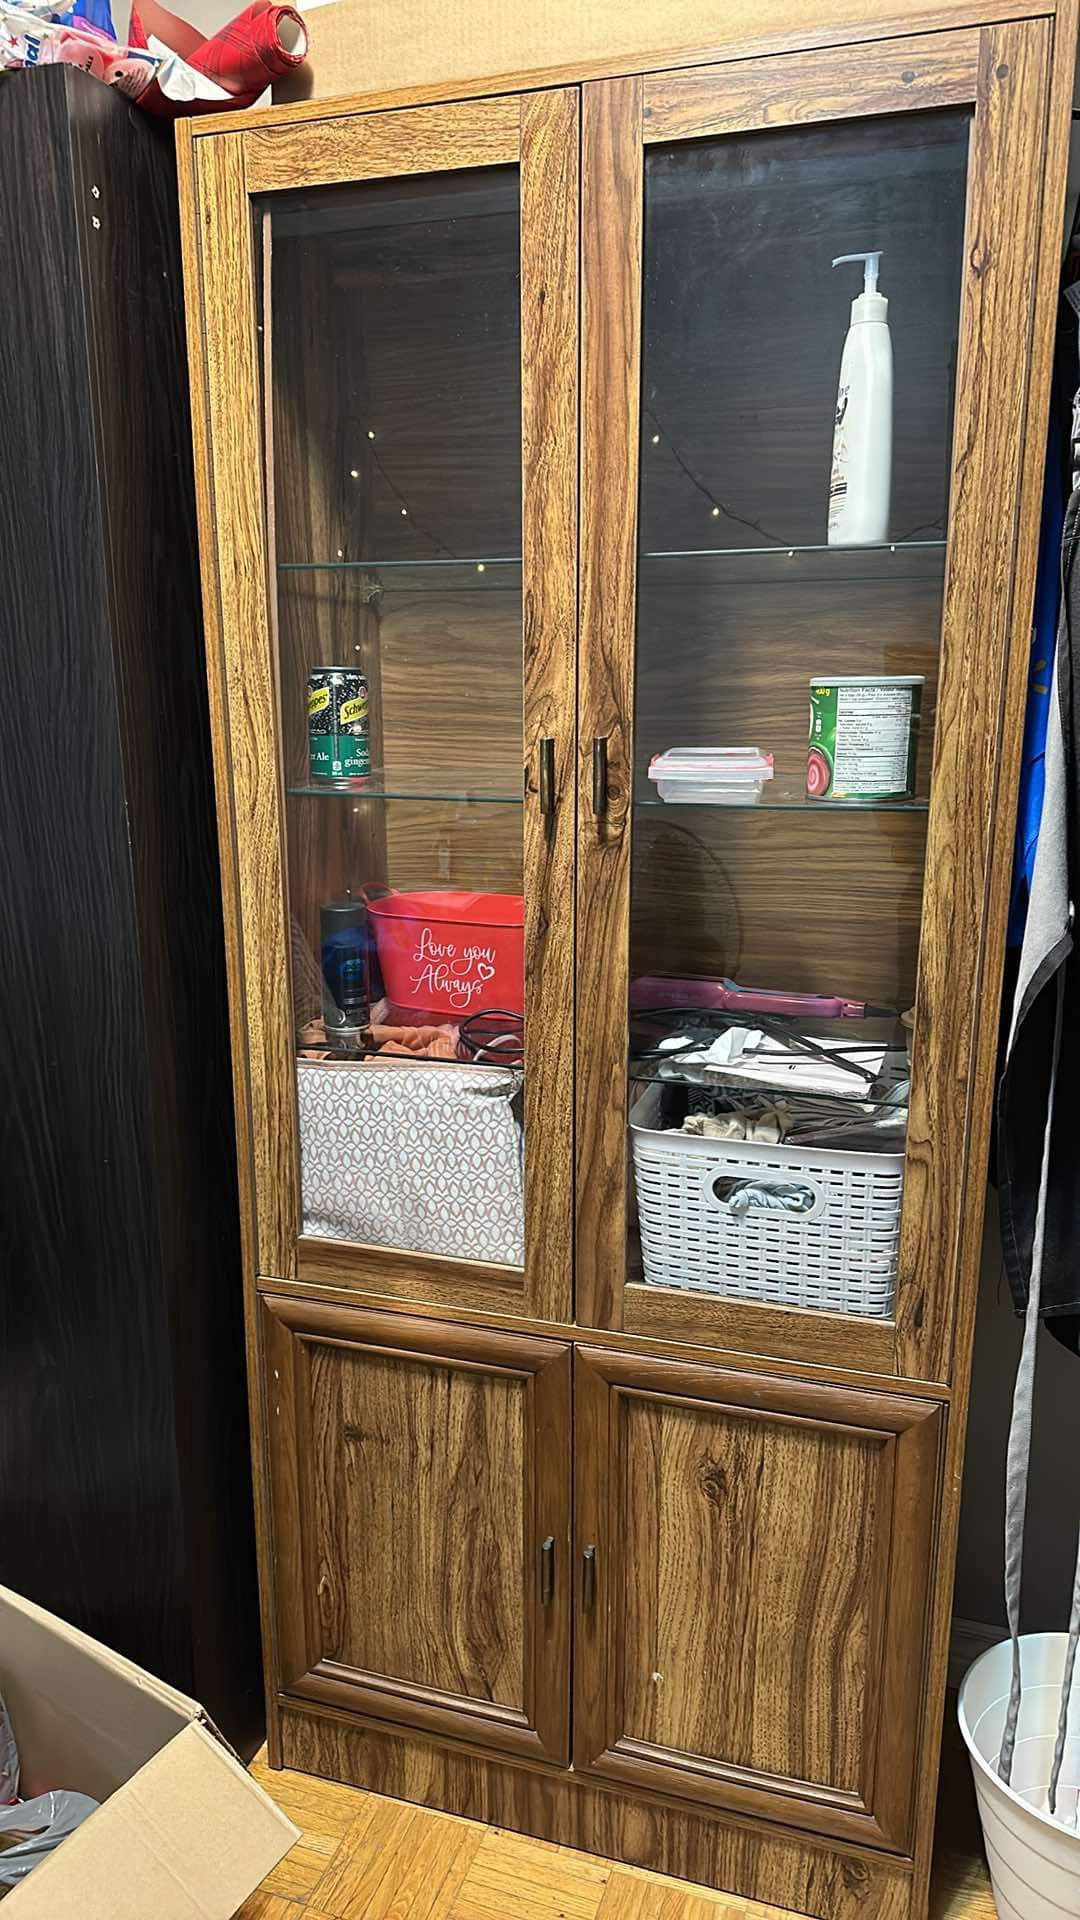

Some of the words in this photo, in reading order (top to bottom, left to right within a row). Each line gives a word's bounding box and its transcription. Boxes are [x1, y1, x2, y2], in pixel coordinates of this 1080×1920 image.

[317, 752, 330, 761] Ale
[412, 927, 457, 963] Love
[450, 945, 496, 976] you
[409, 963, 484, 1009] Always
